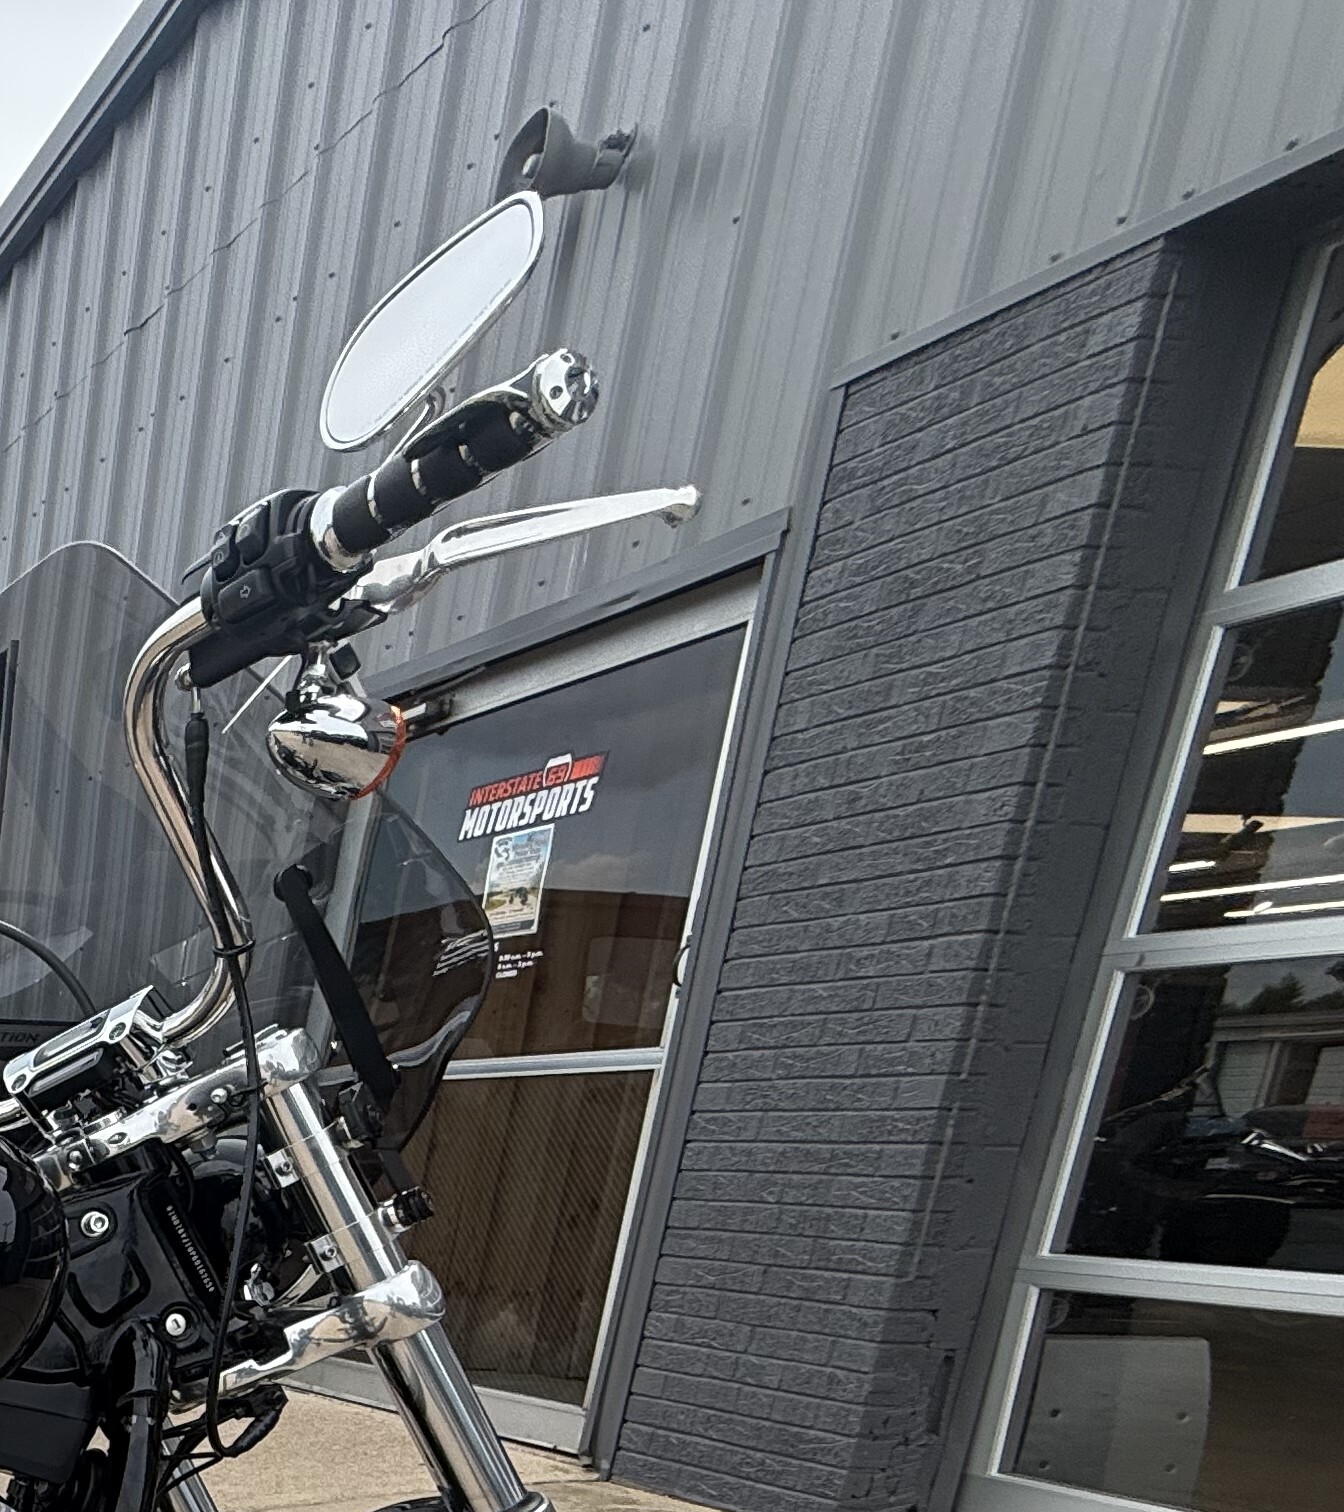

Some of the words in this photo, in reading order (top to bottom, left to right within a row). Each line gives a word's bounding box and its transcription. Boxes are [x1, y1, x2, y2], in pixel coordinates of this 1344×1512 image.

[458, 776, 600, 841] MOTORSPORTS
[469, 771, 543, 807] INTERSTATE
[545, 764, 568, 786] 69
